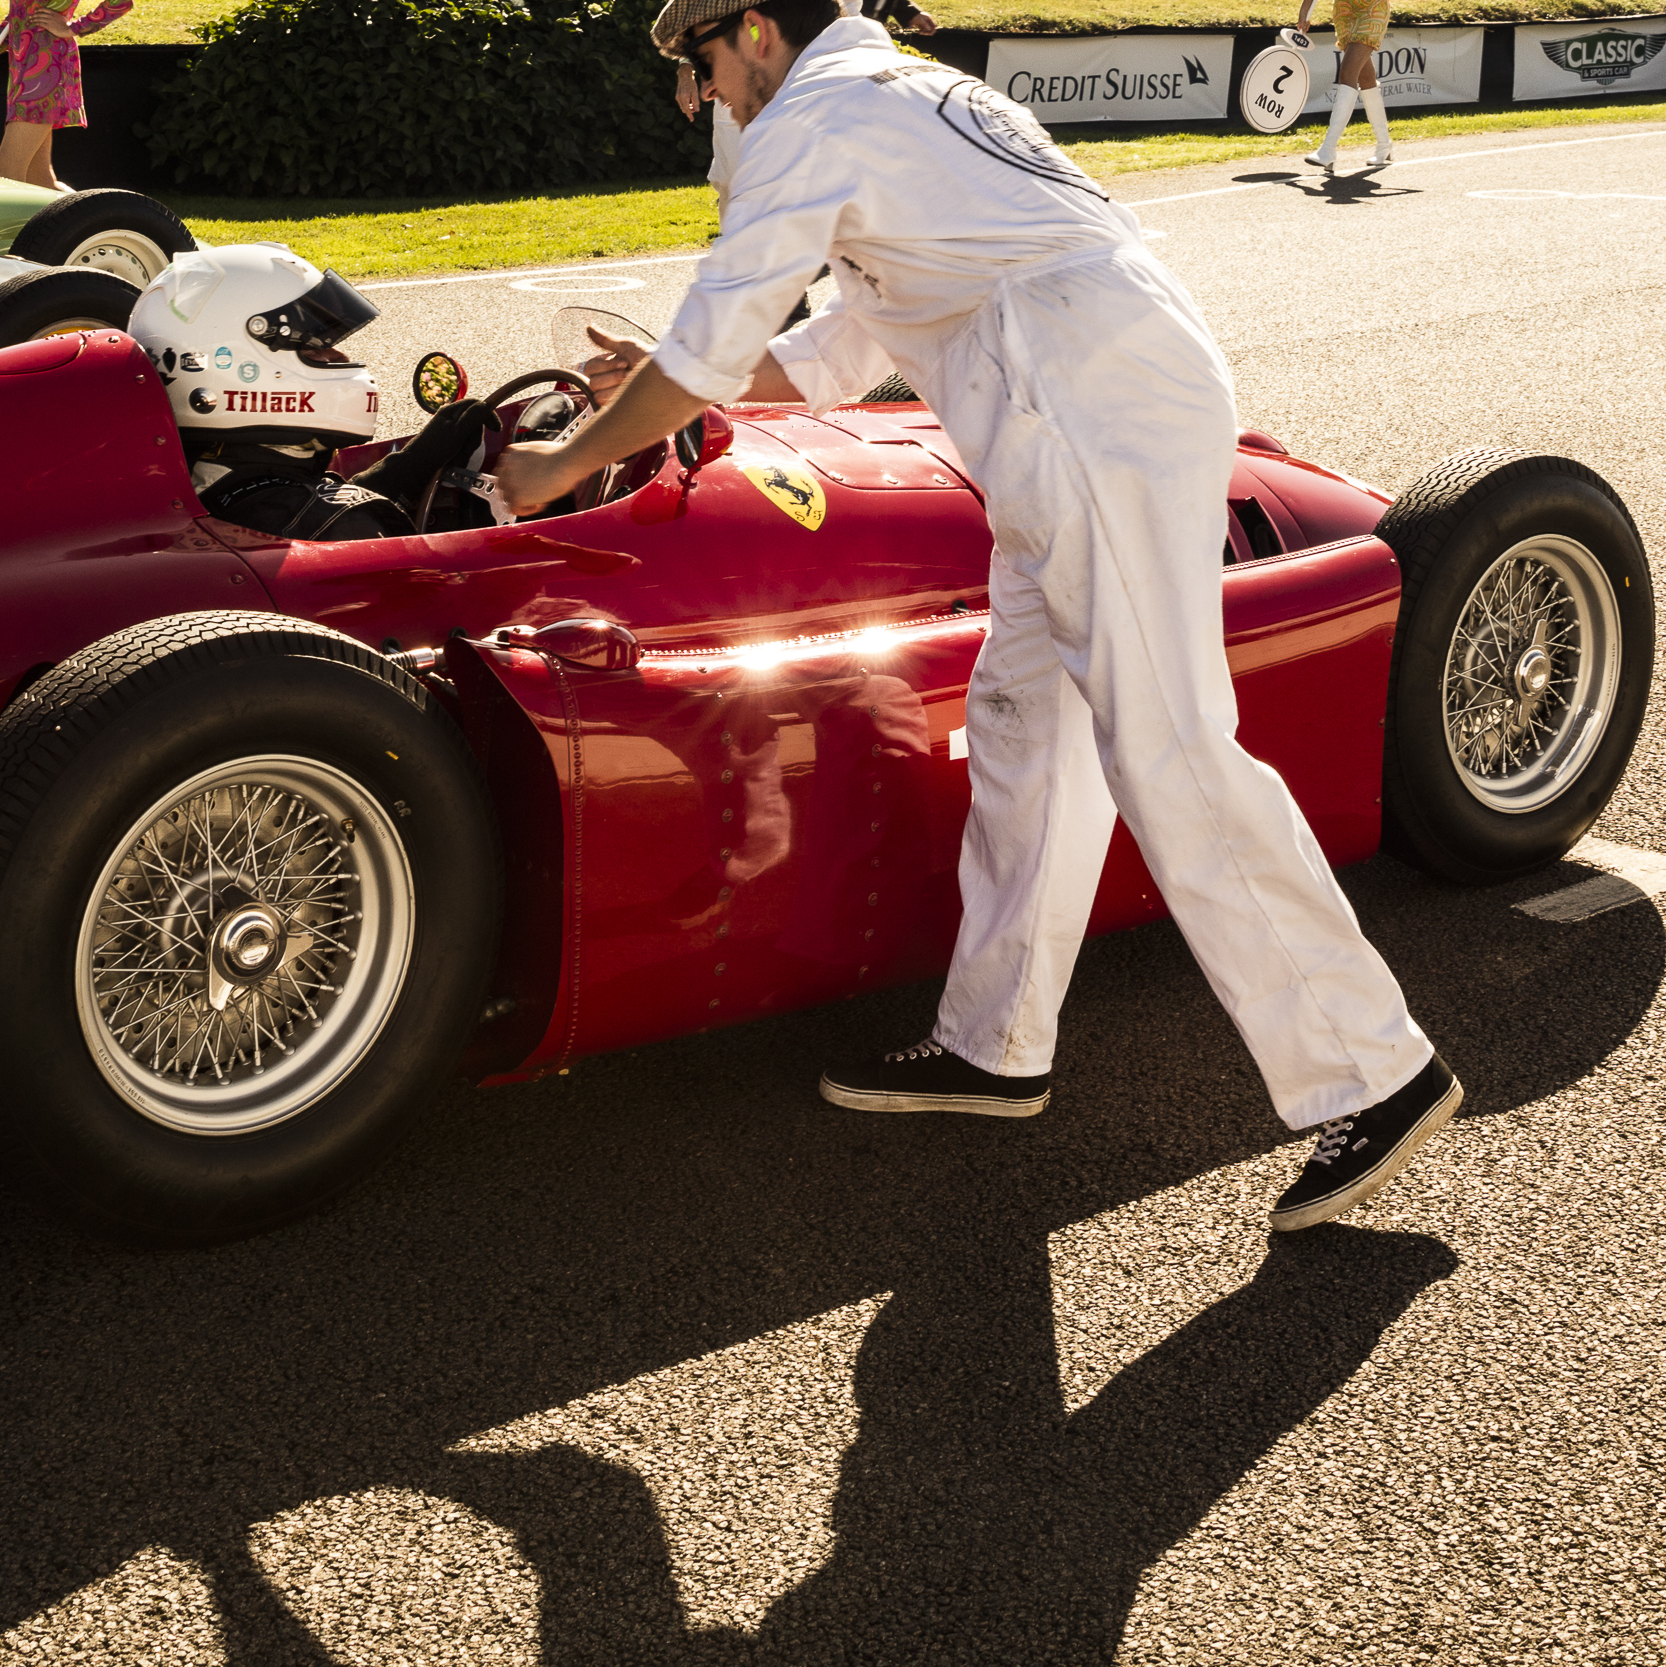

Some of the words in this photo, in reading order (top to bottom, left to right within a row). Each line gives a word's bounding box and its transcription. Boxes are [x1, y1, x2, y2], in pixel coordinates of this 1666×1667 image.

[1566, 38, 1645, 68] CLASSIC
[1007, 71, 1101, 103] CREDIT
[1103, 67, 1183, 100] SUISSE
[1272, 65, 1294, 94] 2
[1590, 68, 1614, 77] SPORTS
[1614, 66, 1628, 75] CAR
[1405, 82, 1432, 95] WATER
[1255, 92, 1285, 119] ROW
